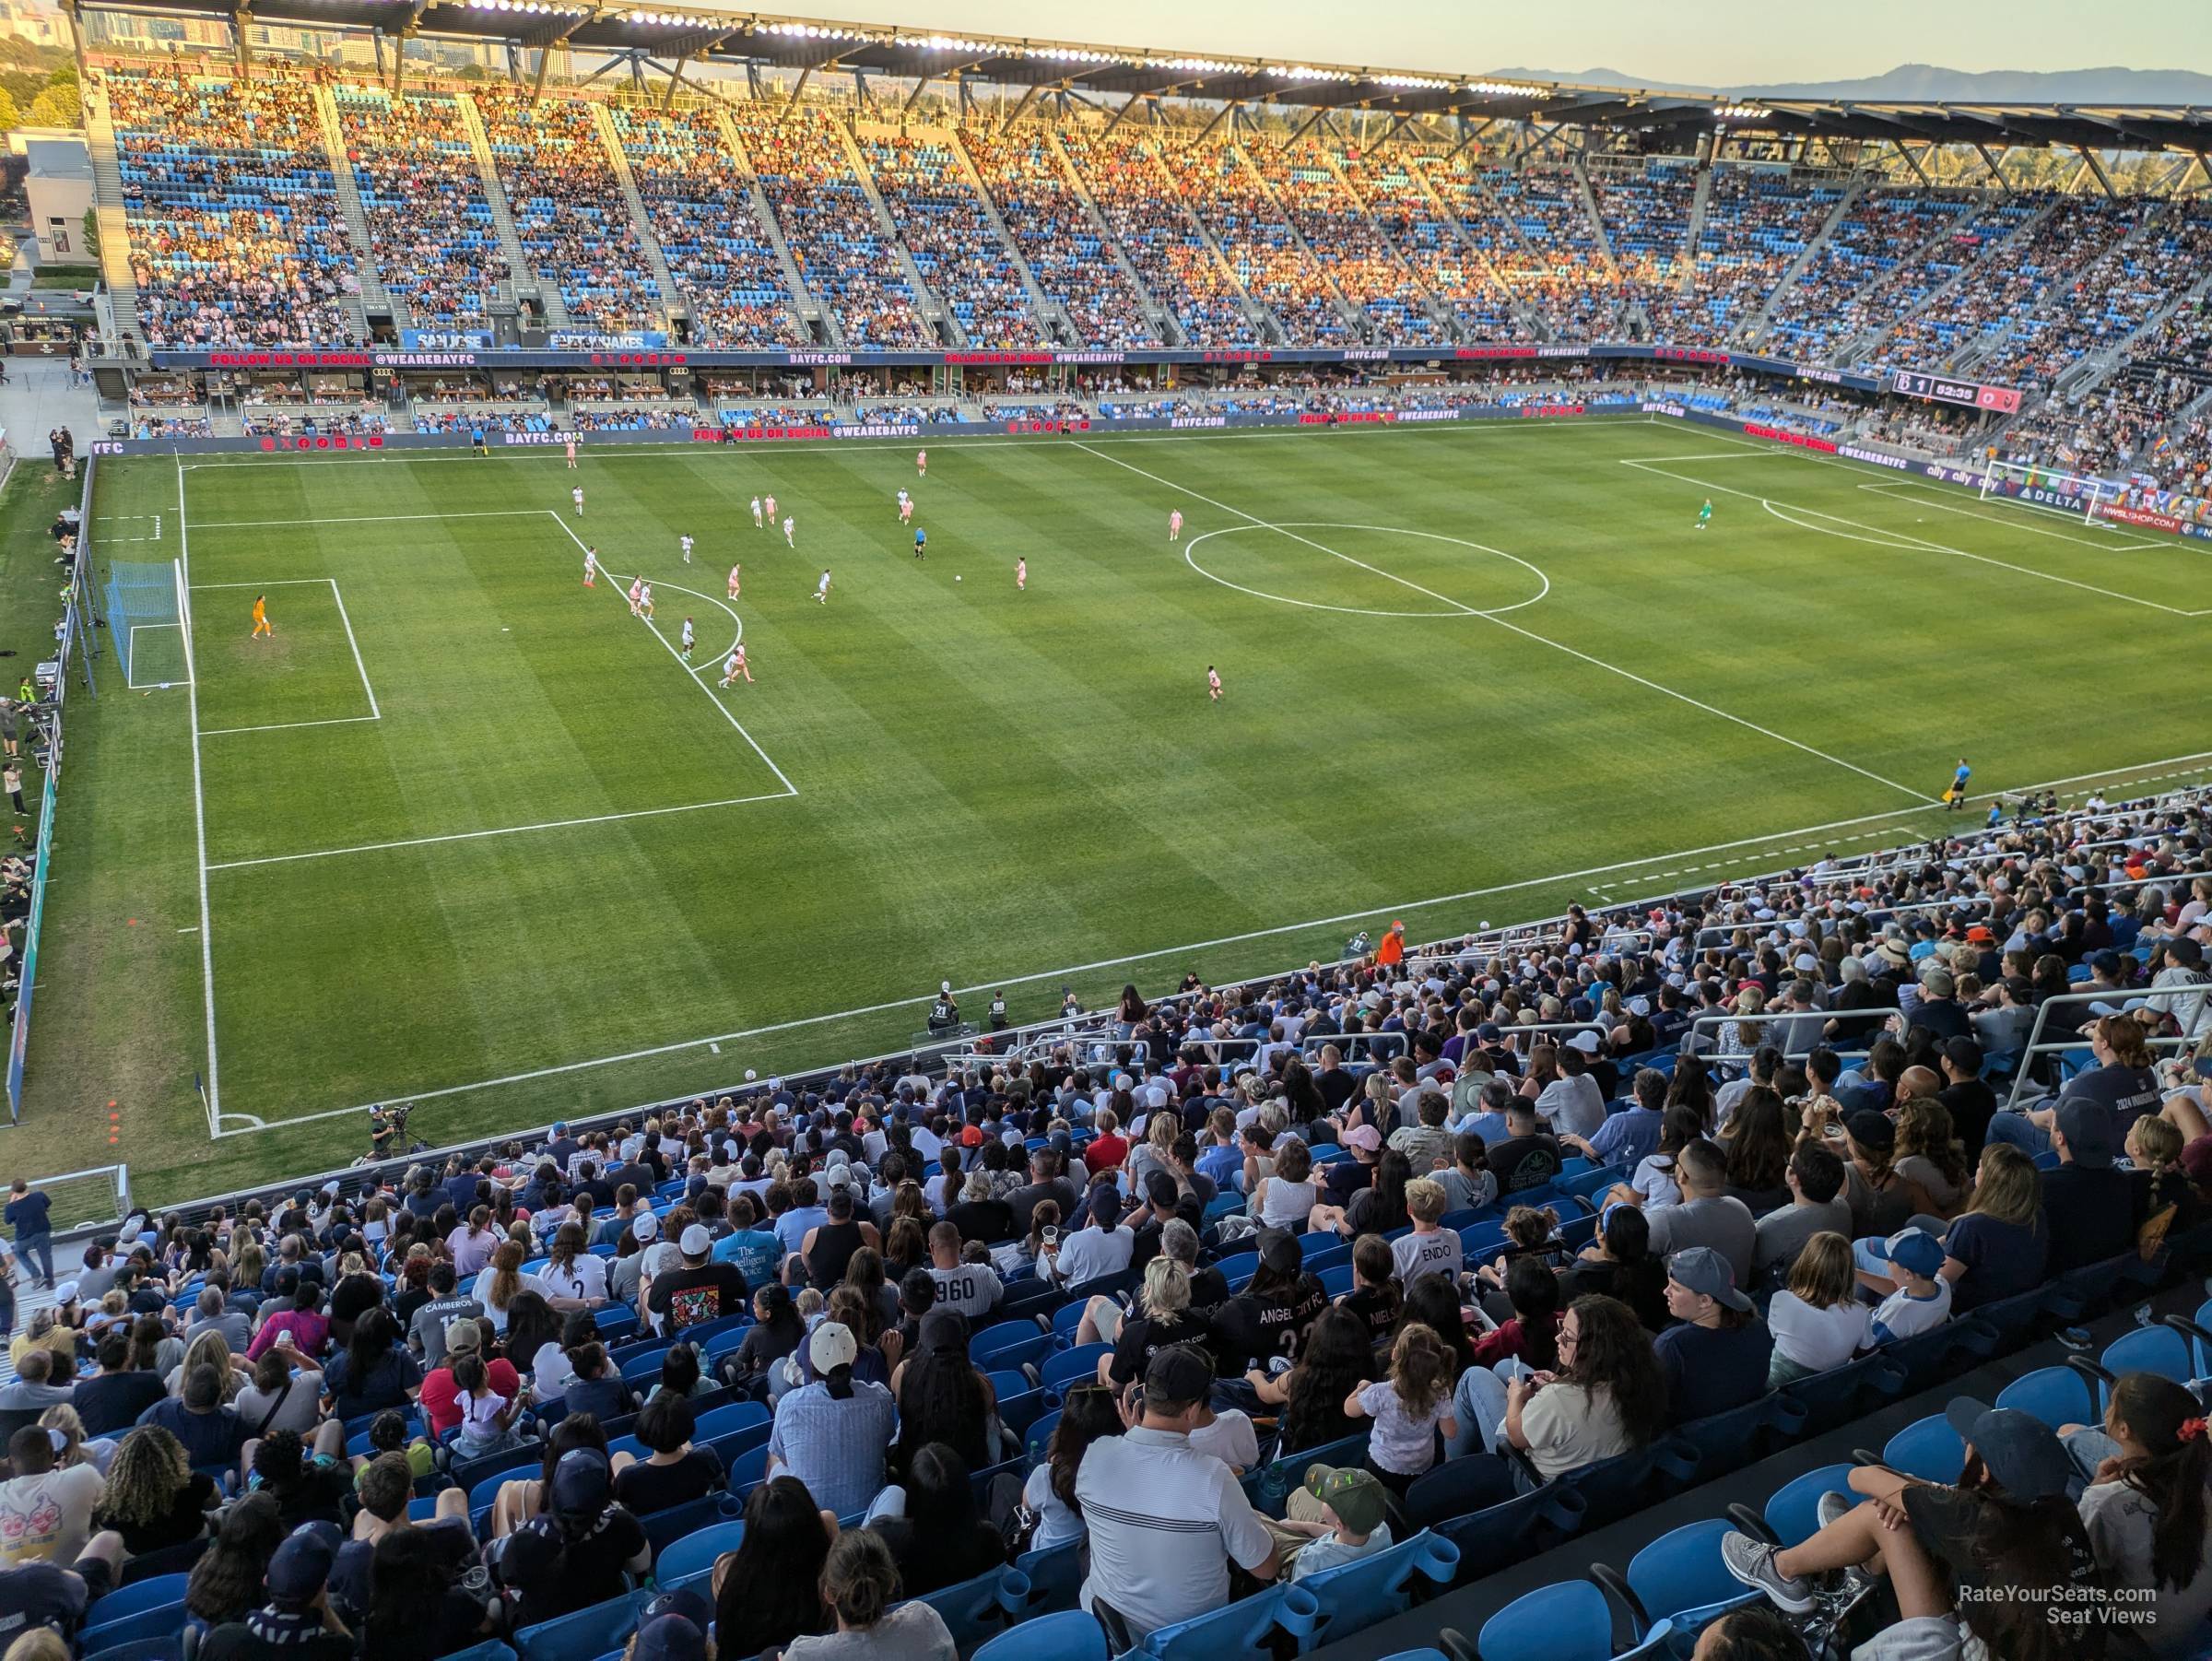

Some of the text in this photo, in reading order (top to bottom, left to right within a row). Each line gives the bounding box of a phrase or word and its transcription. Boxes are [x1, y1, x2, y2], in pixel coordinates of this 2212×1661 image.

[418, 335, 445, 348] SAN
[211, 354, 476, 365] FOLLOW US ON SOCIAL @WEAREBAYFC
[790, 354, 852, 364] BAYFC.COM
[945, 353, 1124, 363] FOLLOW US ON SOCIAL @WEAREBAYFC
[1344, 349, 1390, 359] BAYFC.COM
[1916, 379, 1925, 392] 1
[1936, 383, 1973, 400] 52:35
[1171, 417, 1226, 429] BAYFC.COM
[506, 432, 583, 444] BAYFC.COM
[693, 425, 919, 442] FOLLW US ON SOCIAL @WEAREBAYFC
[93, 442, 124, 454] YFC
[1838, 445, 1907, 469] @WEAREBAYFC
[1926, 465, 1947, 480] ally
[1952, 471, 1972, 486] ally
[2034, 489, 2081, 510] DELTA
[737, 1245, 755, 1255] The
[1422, 1244, 1452, 1262] ENDO
[738, 1266, 762, 1278] hoice
[935, 1277, 975, 1303] 960
[425, 1300, 473, 1313] CAMBEROS
[1260, 1307, 1293, 1325] ANGEL
[1312, 1291, 1323, 1307] FC
